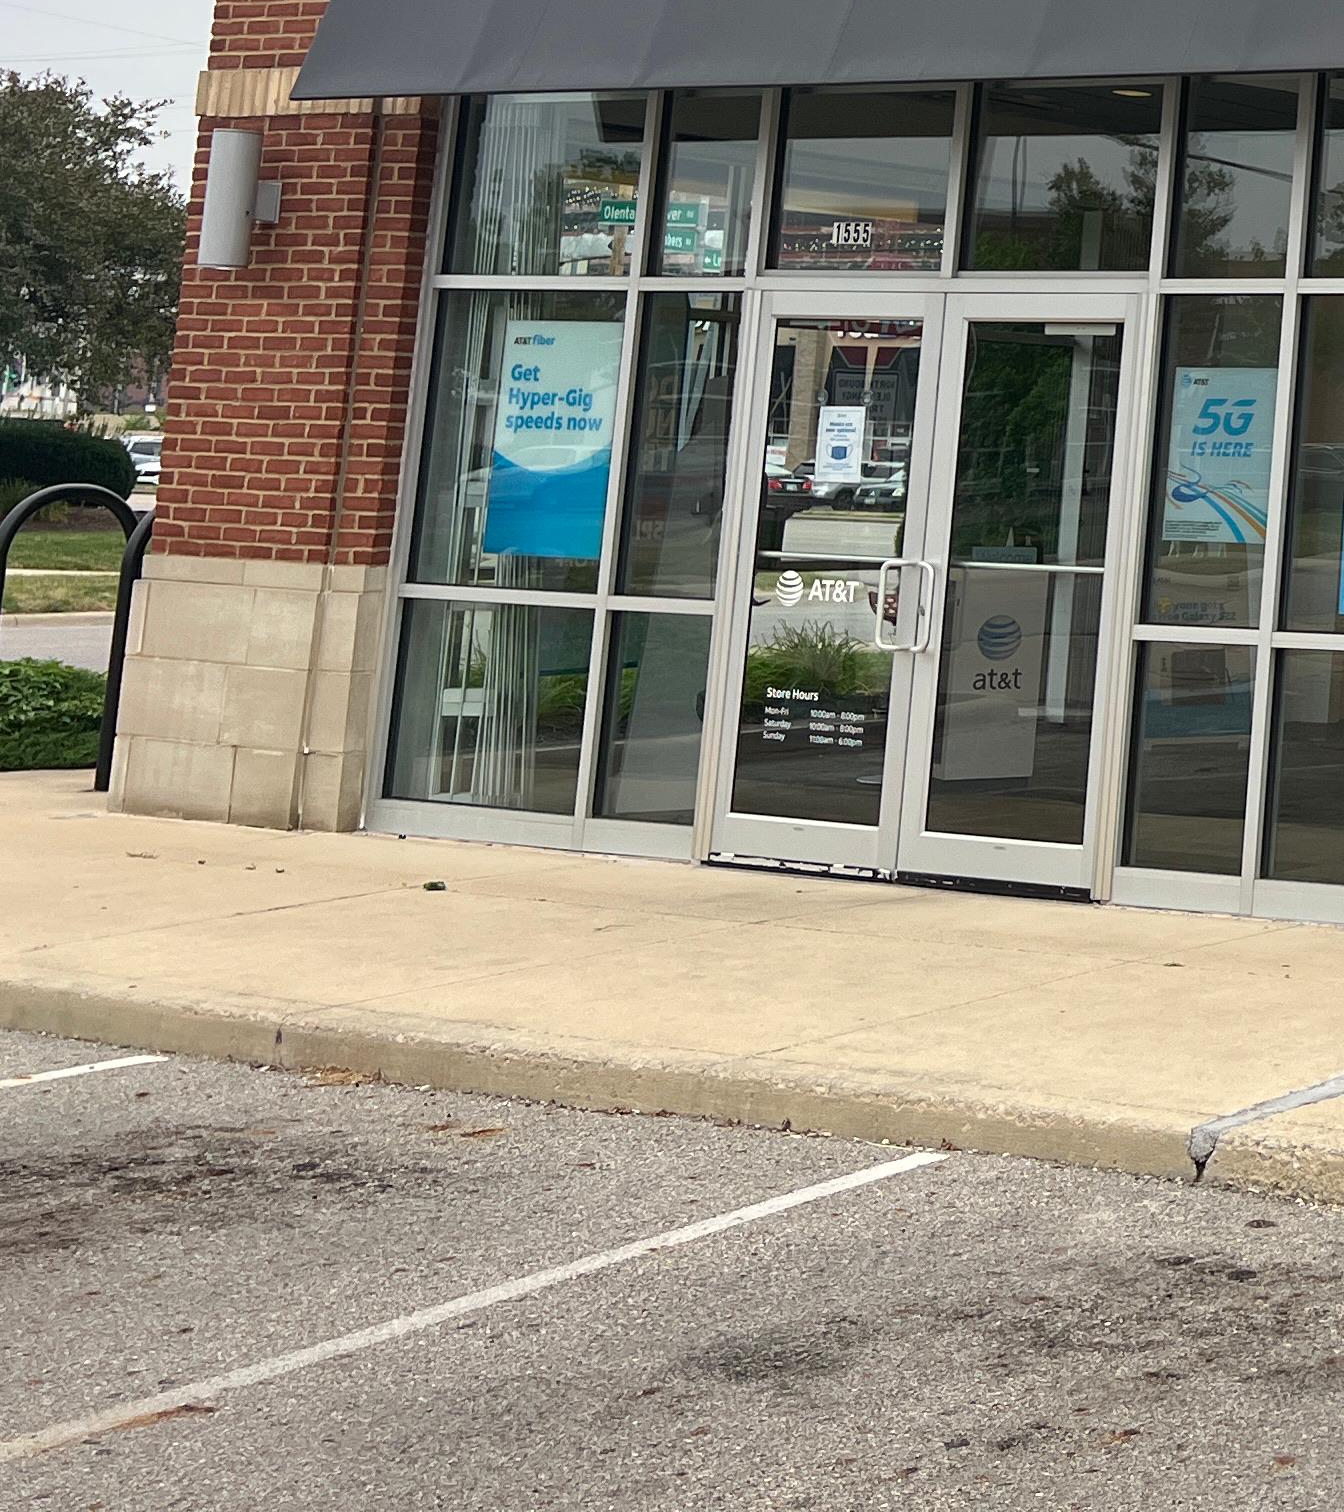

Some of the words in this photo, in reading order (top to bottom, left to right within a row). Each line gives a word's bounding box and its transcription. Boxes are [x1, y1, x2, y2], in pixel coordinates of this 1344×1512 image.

[603, 205, 636, 221] Olenta
[835, 223, 871, 243] 1555
[513, 336, 532, 345] AT&T
[532, 334, 556, 346] fiber
[511, 364, 541, 382] Get
[508, 388, 593, 413] Hyper-Gig
[505, 411, 563, 434] speeds
[566, 416, 603, 431] now
[1192, 398, 1257, 437] 5G
[1190, 441, 1207, 457] IS
[1210, 441, 1254, 458] HERE
[808, 578, 860, 603] AT&T
[972, 668, 1023, 691] at&t
[766, 687, 791, 700] Store
[792, 689, 819, 702] Hours
[764, 706, 790, 717] Mon-Fri
[763, 718, 792, 730] Saturday
[762, 731, 786, 743] Sunday
